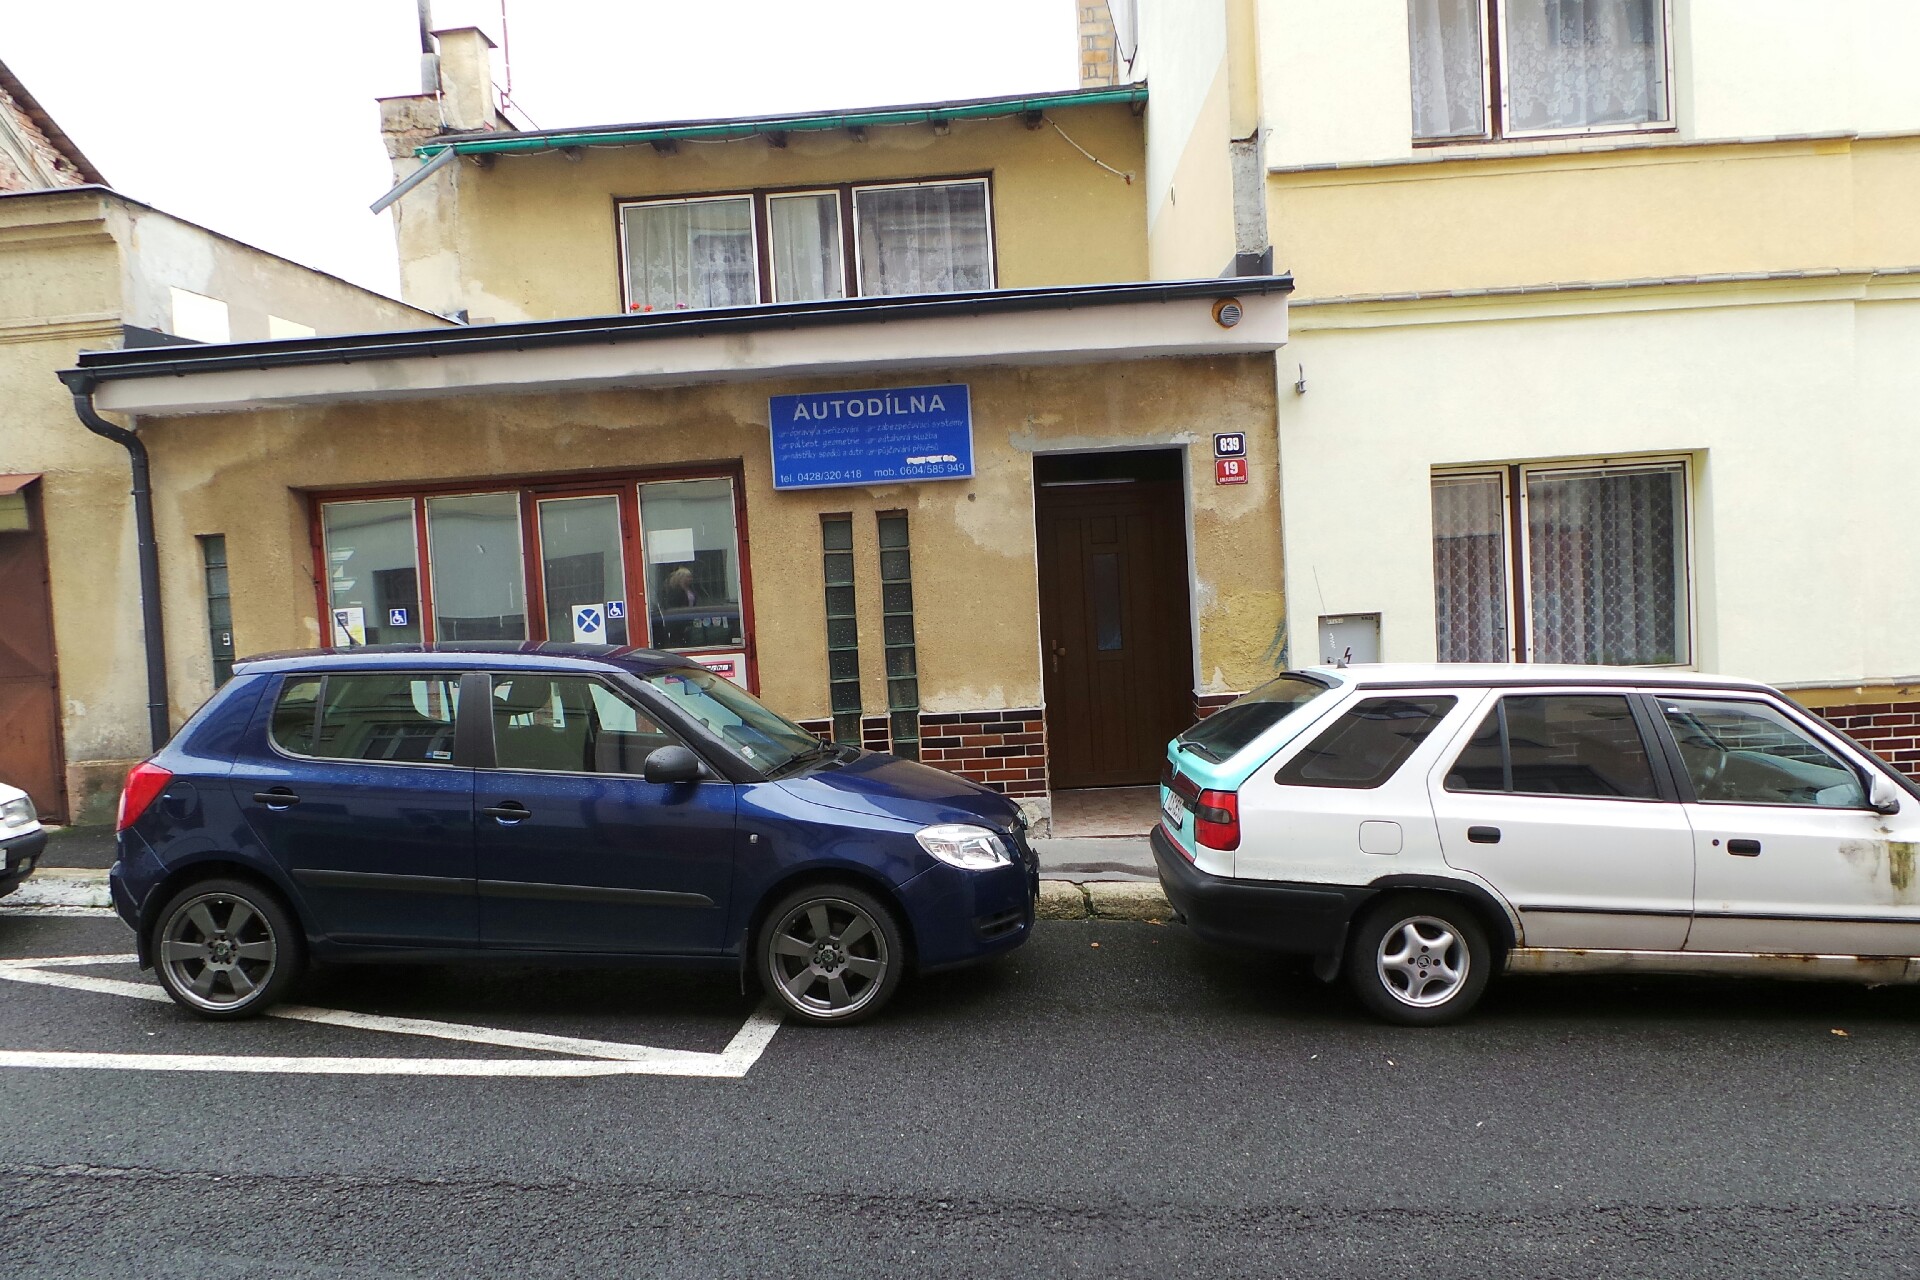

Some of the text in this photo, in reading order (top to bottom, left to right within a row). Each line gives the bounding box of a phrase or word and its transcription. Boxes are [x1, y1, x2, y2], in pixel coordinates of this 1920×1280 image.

[793, 393, 946, 421] AUTODÍLNA
[1220, 437, 1240, 452] 839
[874, 462, 965, 478] mob. 0604/585 949
[1223, 461, 1239, 475] 19
[780, 469, 863, 483] tel. 0428/320 418
